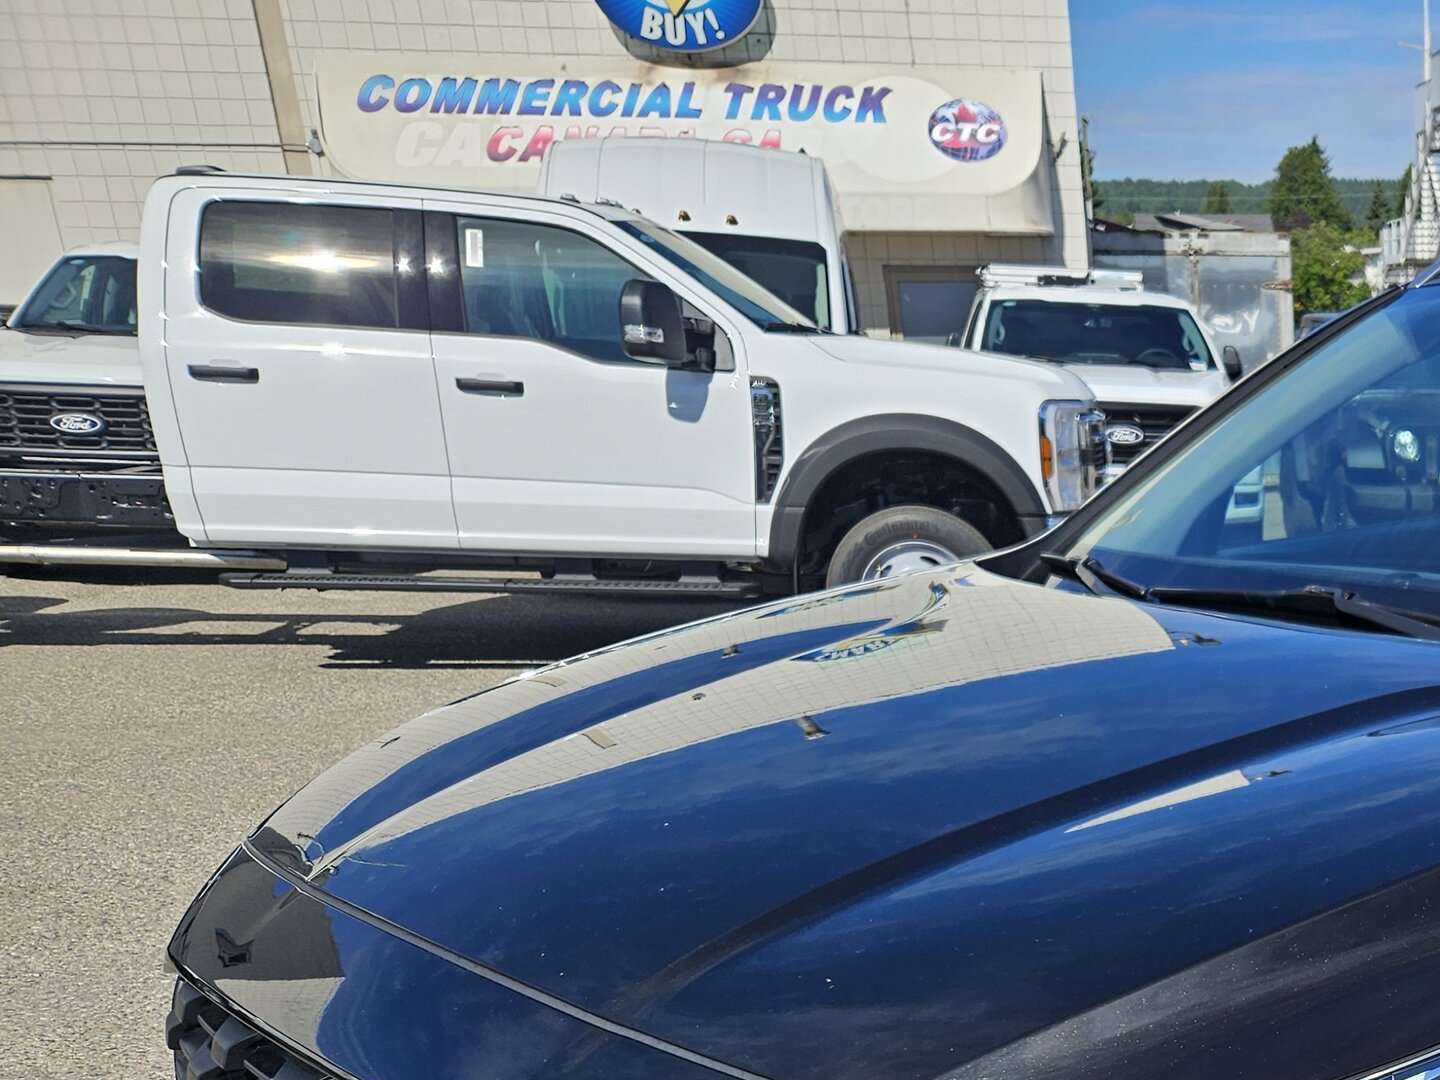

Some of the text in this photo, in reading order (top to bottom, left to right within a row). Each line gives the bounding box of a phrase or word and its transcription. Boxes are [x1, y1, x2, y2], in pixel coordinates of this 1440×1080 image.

[640, 6, 725, 46] BUY!
[356, 74, 893, 124] COMMERCIAL TRUCK
[931, 121, 1001, 144] CTC
